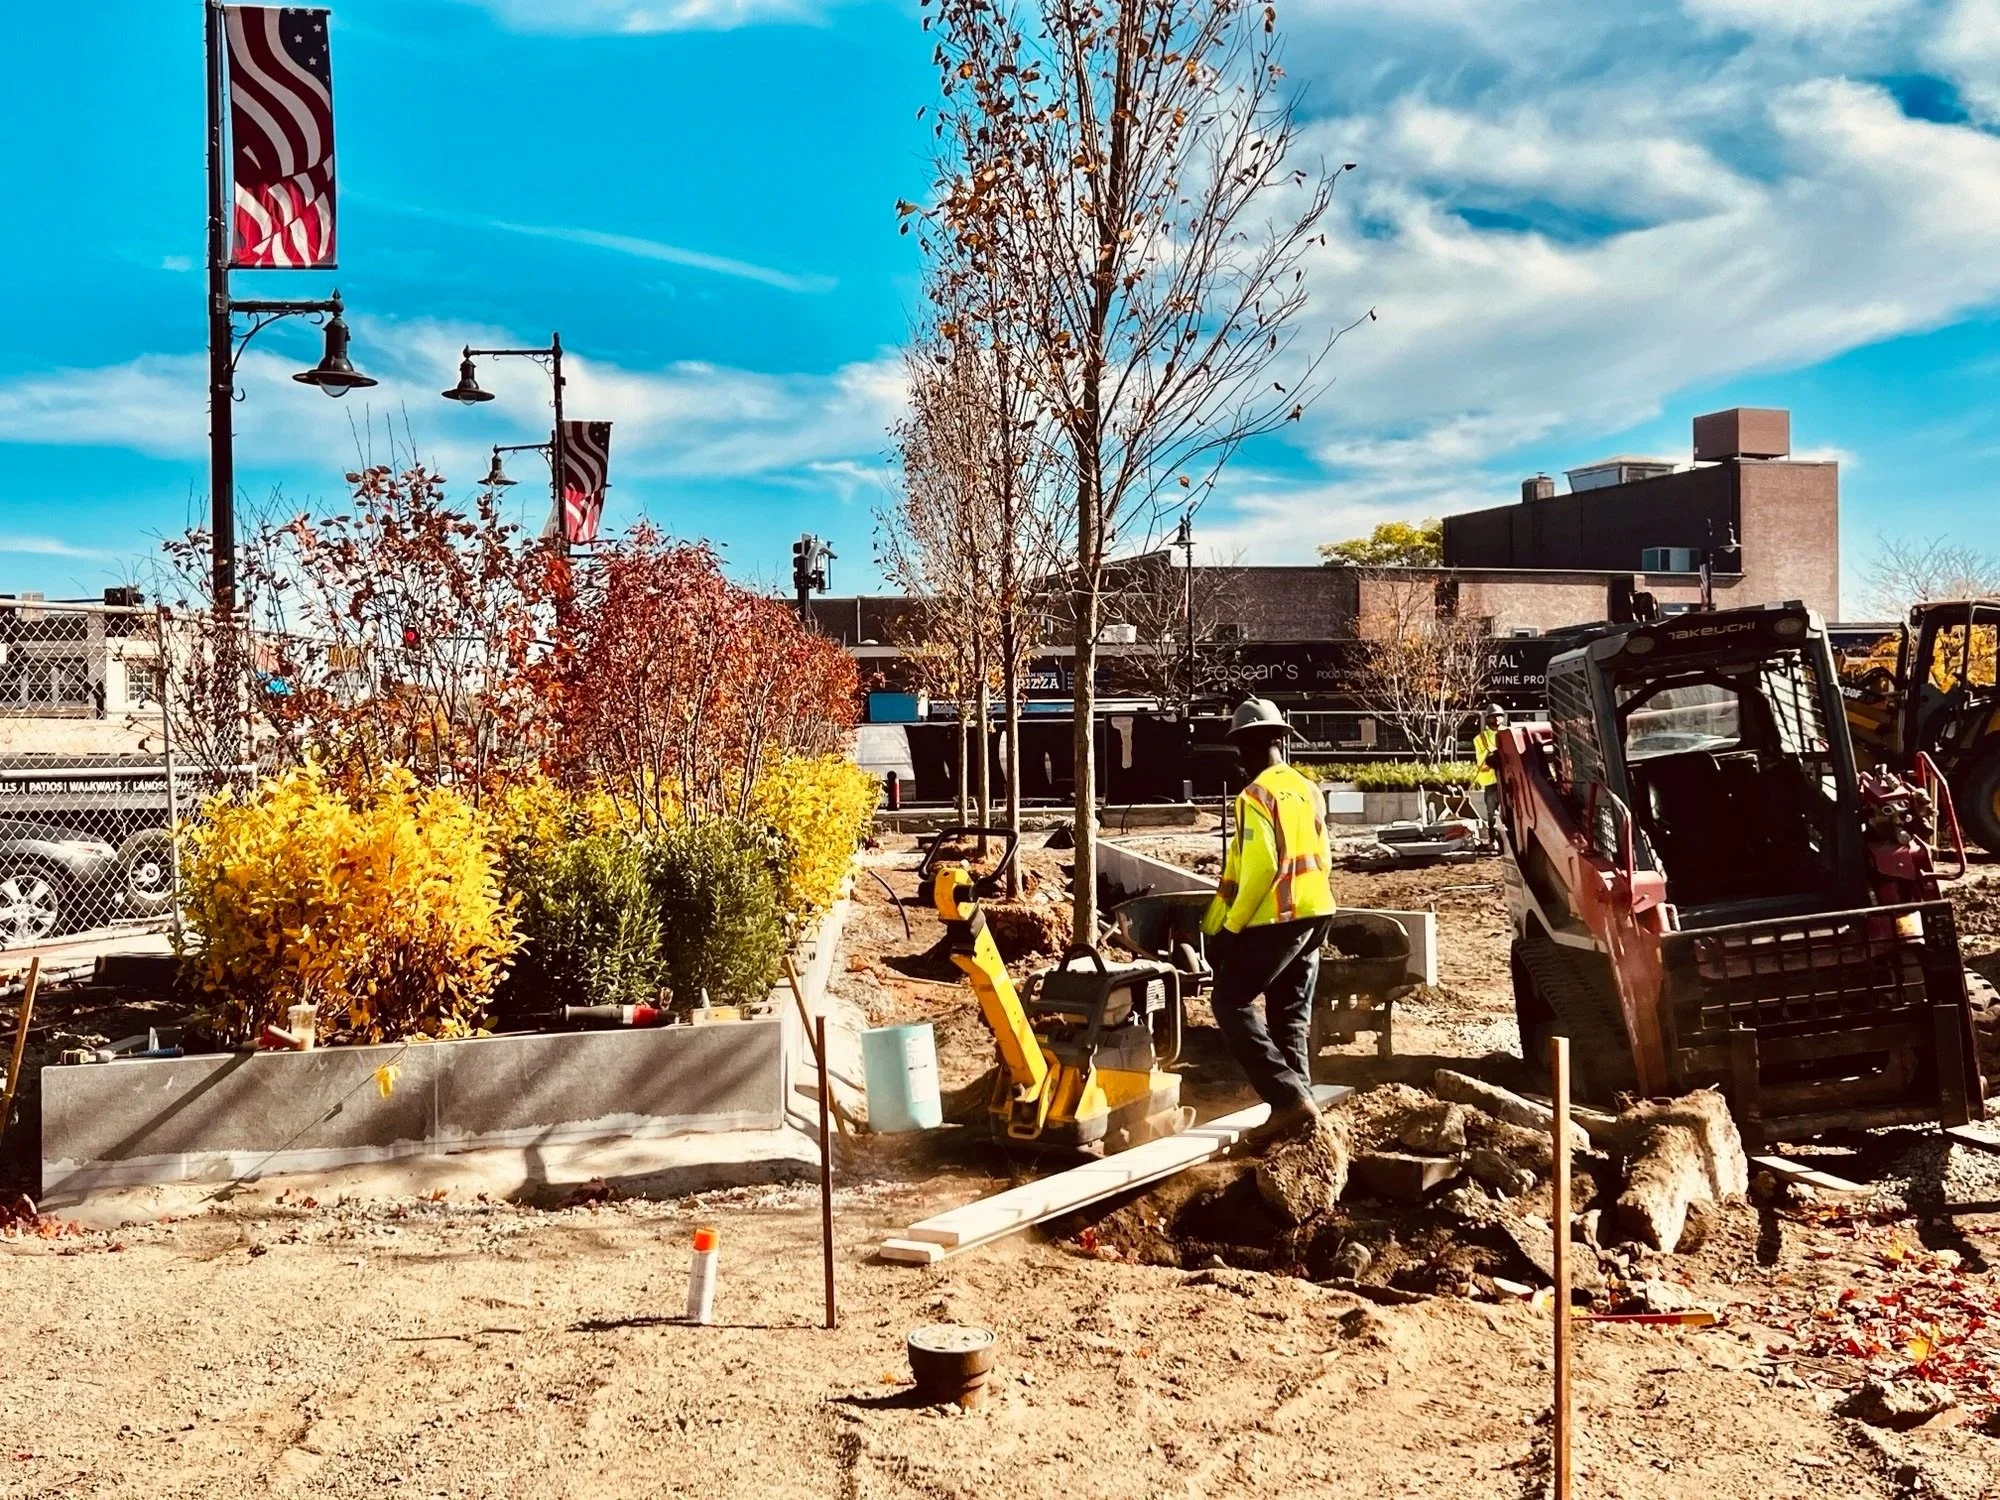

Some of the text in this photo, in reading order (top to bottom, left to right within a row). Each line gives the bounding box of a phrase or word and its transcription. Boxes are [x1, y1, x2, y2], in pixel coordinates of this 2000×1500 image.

[1444, 655, 1518, 669] ENRAL
[1213, 660, 1299, 681] oscar's
[1017, 678, 1060, 689] PIZZA
[1491, 675, 1547, 685] WINE PRO
[1284, 741, 1332, 750] ERRARA
[29, 782, 63, 792] PATIOS
[69, 781, 122, 792] WALKWAYS
